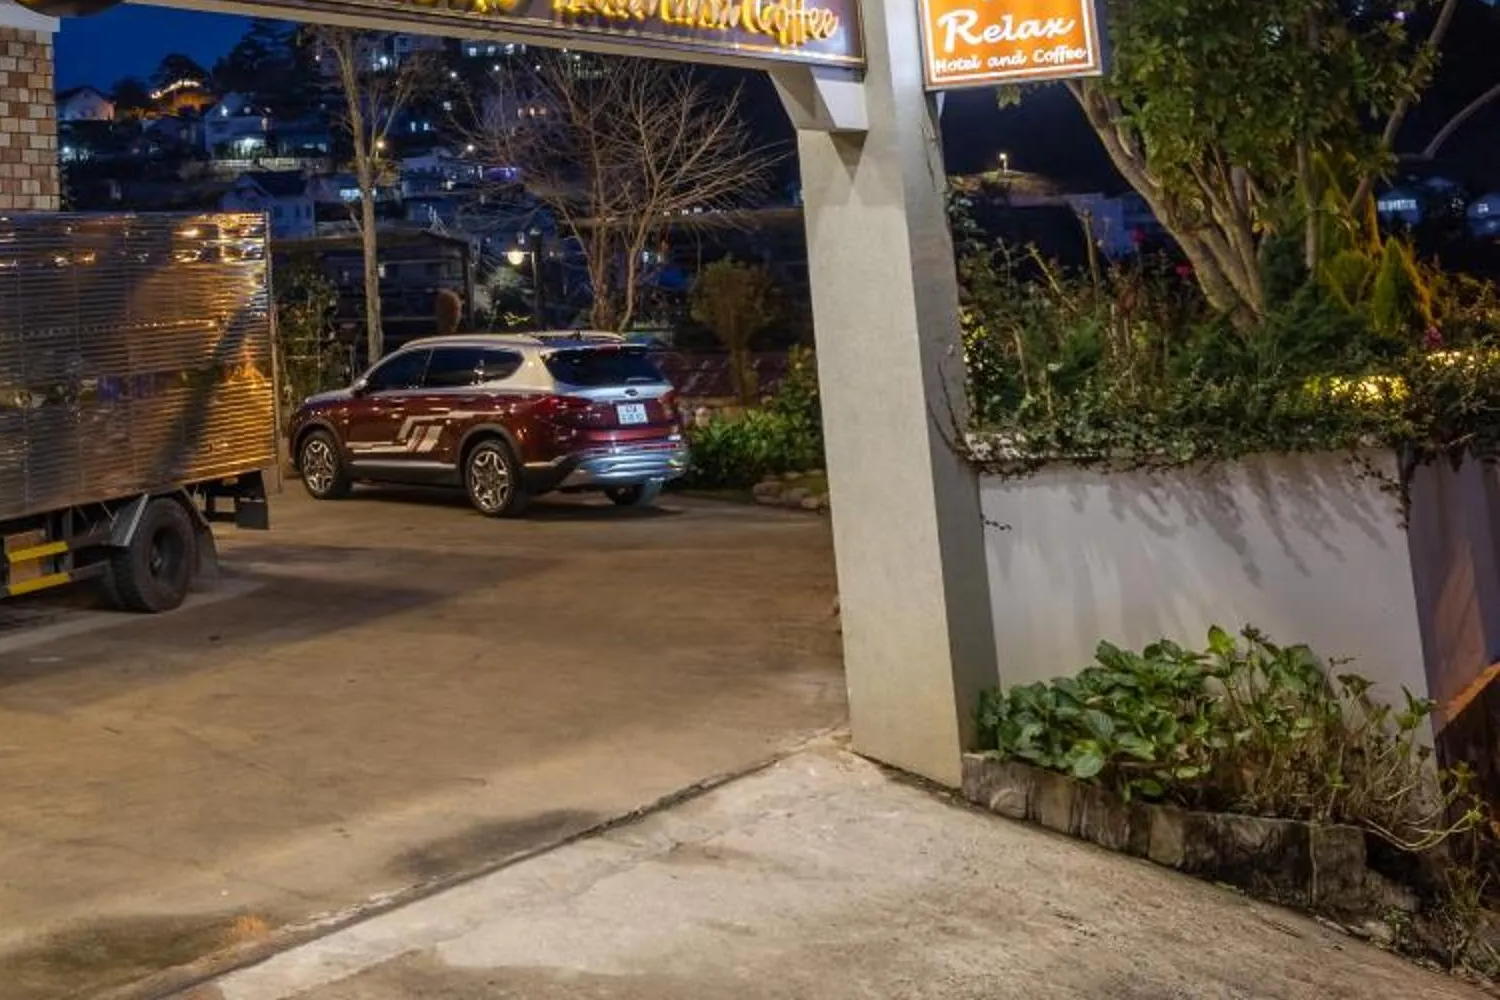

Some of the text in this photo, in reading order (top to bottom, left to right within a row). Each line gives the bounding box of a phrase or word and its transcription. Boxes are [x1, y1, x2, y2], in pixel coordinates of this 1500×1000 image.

[937, 8, 1075, 53] Relax
[934, 45, 1087, 75] Hotel and Coffee
